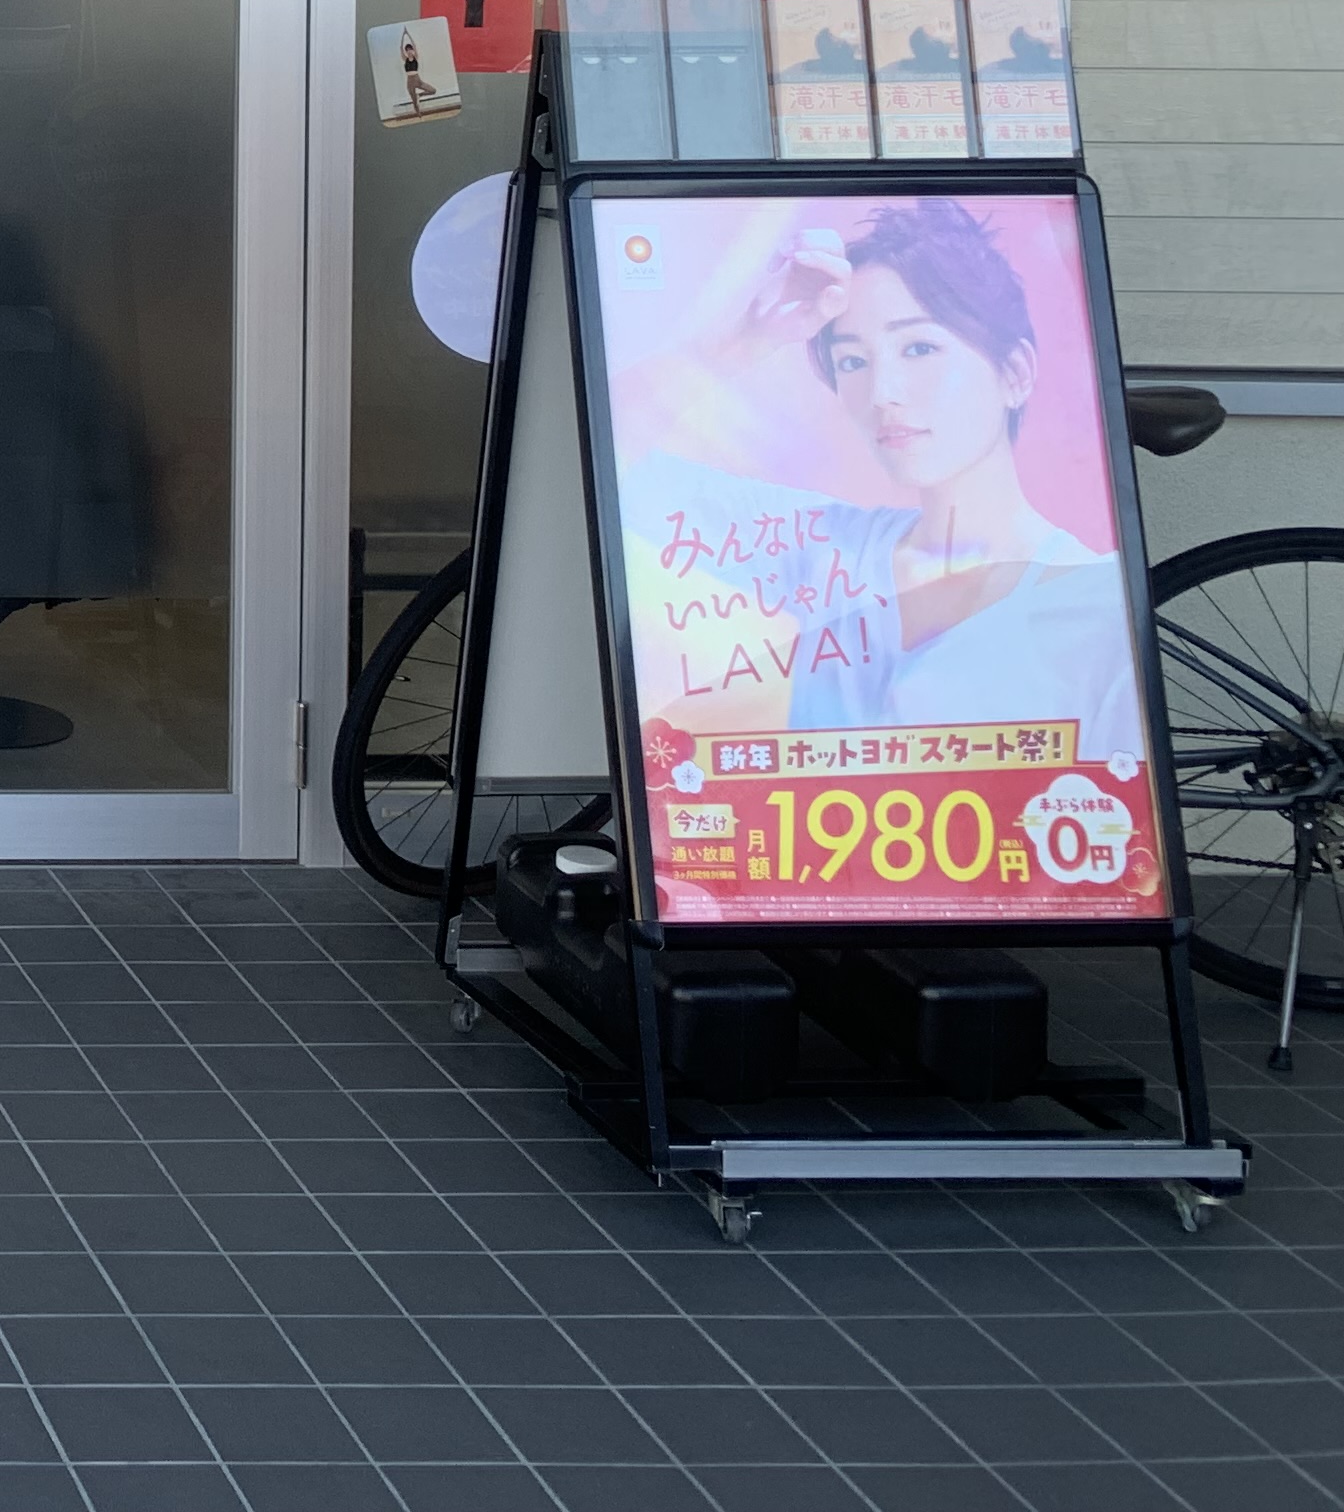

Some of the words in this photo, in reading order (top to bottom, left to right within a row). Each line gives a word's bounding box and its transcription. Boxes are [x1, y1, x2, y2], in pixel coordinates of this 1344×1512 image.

[659, 506, 830, 578] みんなに
[664, 547, 890, 632] いいじゃん、
[680, 615, 874, 698] LAVA!
[719, 743, 773, 772] 新年
[674, 809, 728, 832] 今だけ
[1039, 797, 1115, 814] 手ぶら体験
[671, 845, 736, 863] 通い放題
[747, 829, 772, 881] 月額
